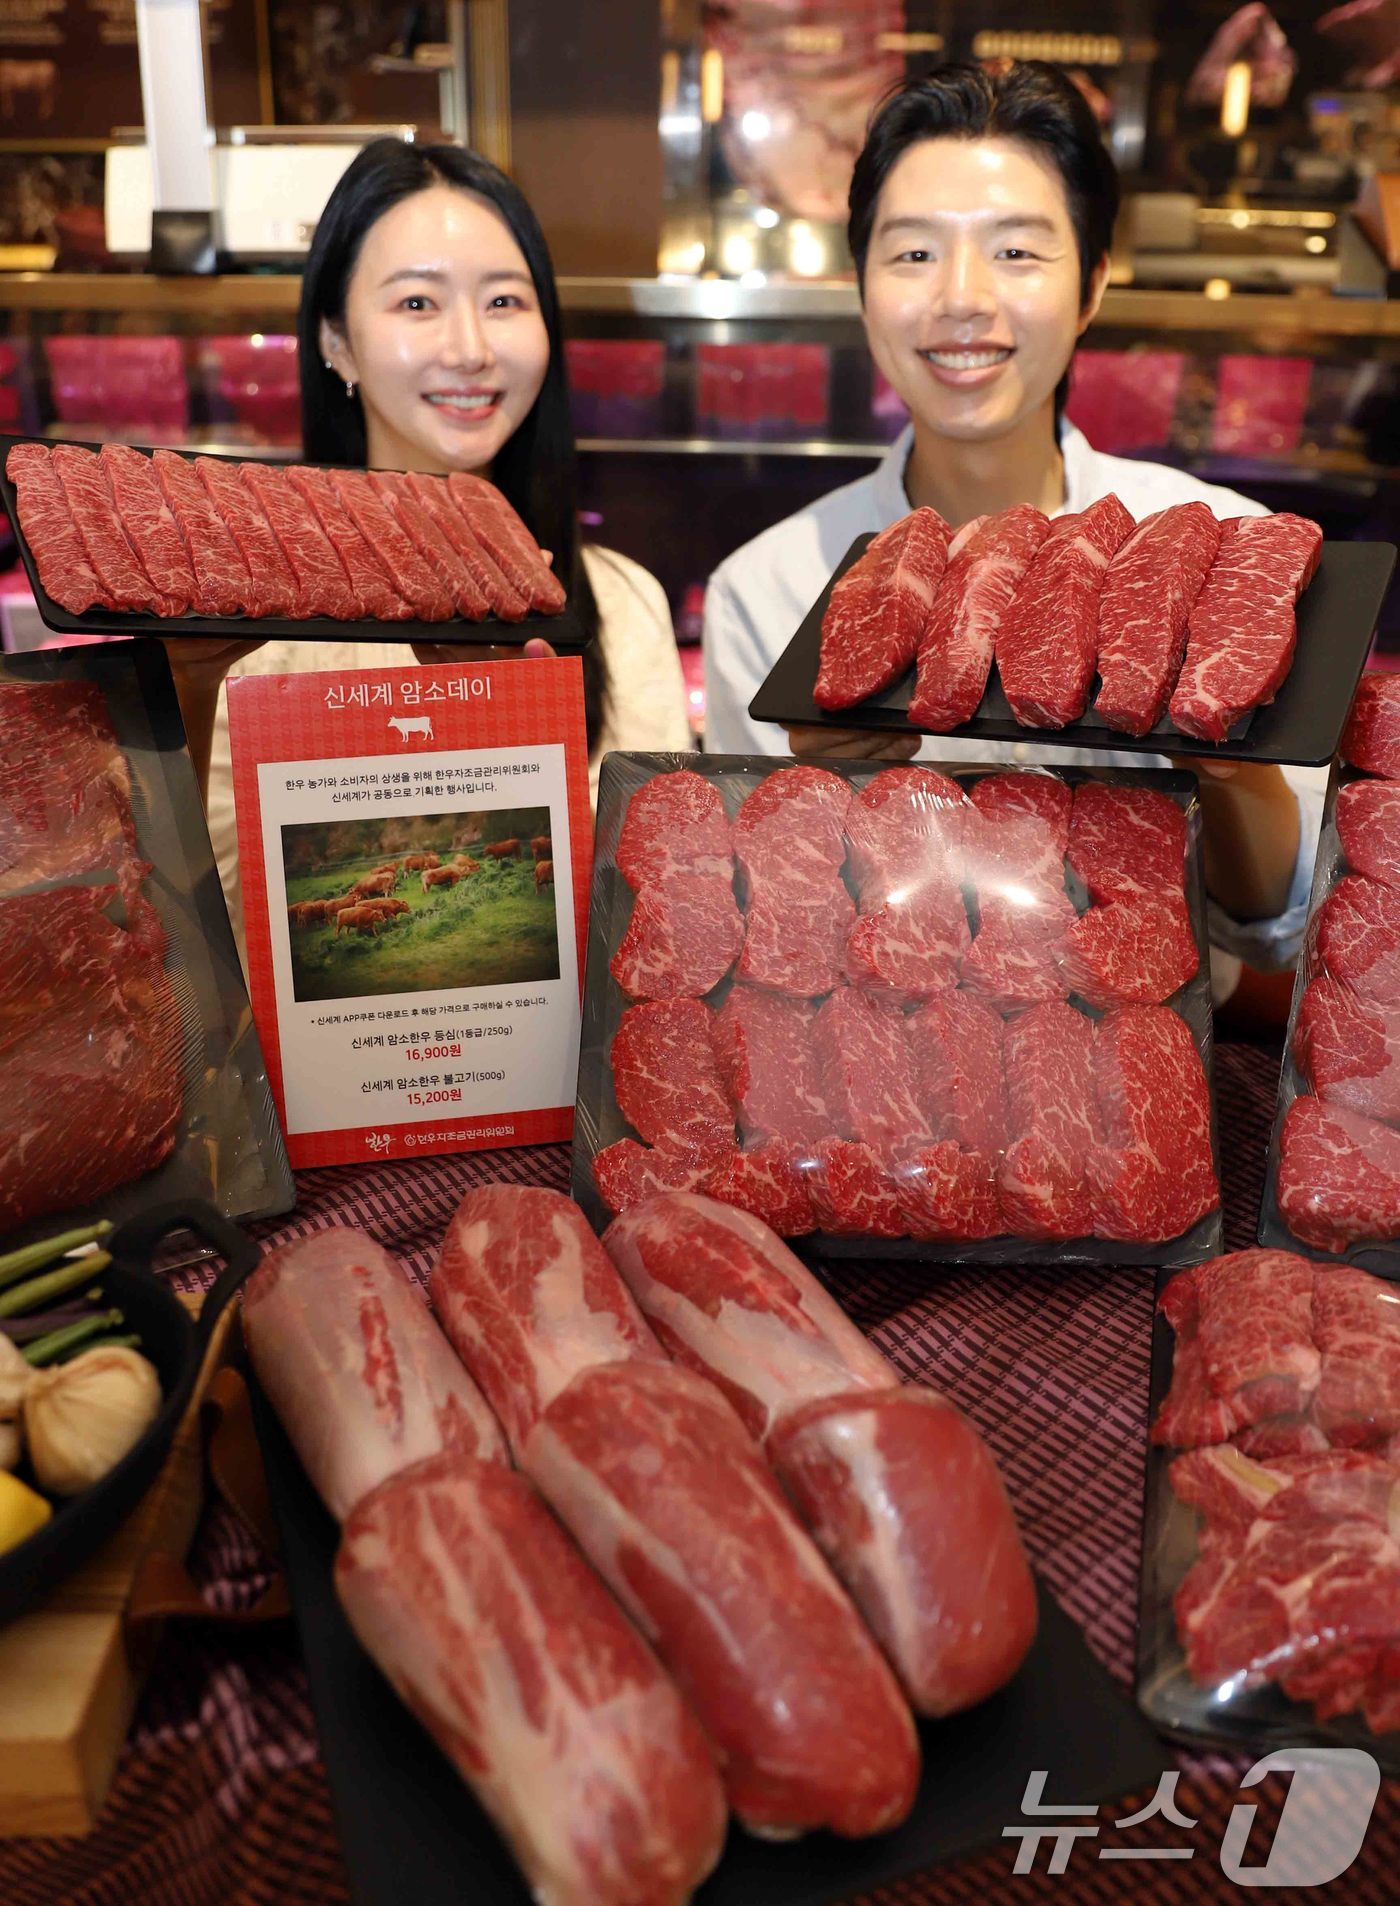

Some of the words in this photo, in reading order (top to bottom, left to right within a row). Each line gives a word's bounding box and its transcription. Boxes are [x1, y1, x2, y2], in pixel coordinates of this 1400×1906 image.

[324, 682, 393, 709] 신세계
[400, 676, 492, 705] 암소데이
[285, 779, 305, 791] 한우
[308, 776, 337, 789] 농가와
[340, 773, 379, 787] 소비자의
[381, 771, 410, 784] 상생을
[413, 769, 433, 782] 위해
[435, 763, 540, 780] 한우자조금관리위원회와
[332, 790, 371, 803] 신세계가
[374, 787, 412, 800] 공동으로
[447, 781, 497, 795] 행사입니다.
[317, 1015, 341, 1026] 신세계
[377, 1009, 409, 1019] 다운로드
[411, 1008, 419, 1017] 후
[421, 1005, 437, 1016] 해당
[439, 1002, 470, 1014] 가격으로
[472, 999, 503, 1011] 구매하실
[505, 998, 513, 1008] 수
[515, 997, 549, 1007] 있습니다.
[351, 1037, 385, 1050] 신세계
[387, 1031, 431, 1046] 암소한우
[434, 1025, 513, 1041] 등심(1등급/250g)
[405, 1044, 462, 1061] 16,900원
[361, 1080, 394, 1094] 신세계
[397, 1075, 440, 1089] 암소한우
[443, 1070, 506, 1085] 불고기(500g)
[407, 1089, 462, 1106] 15,200원
